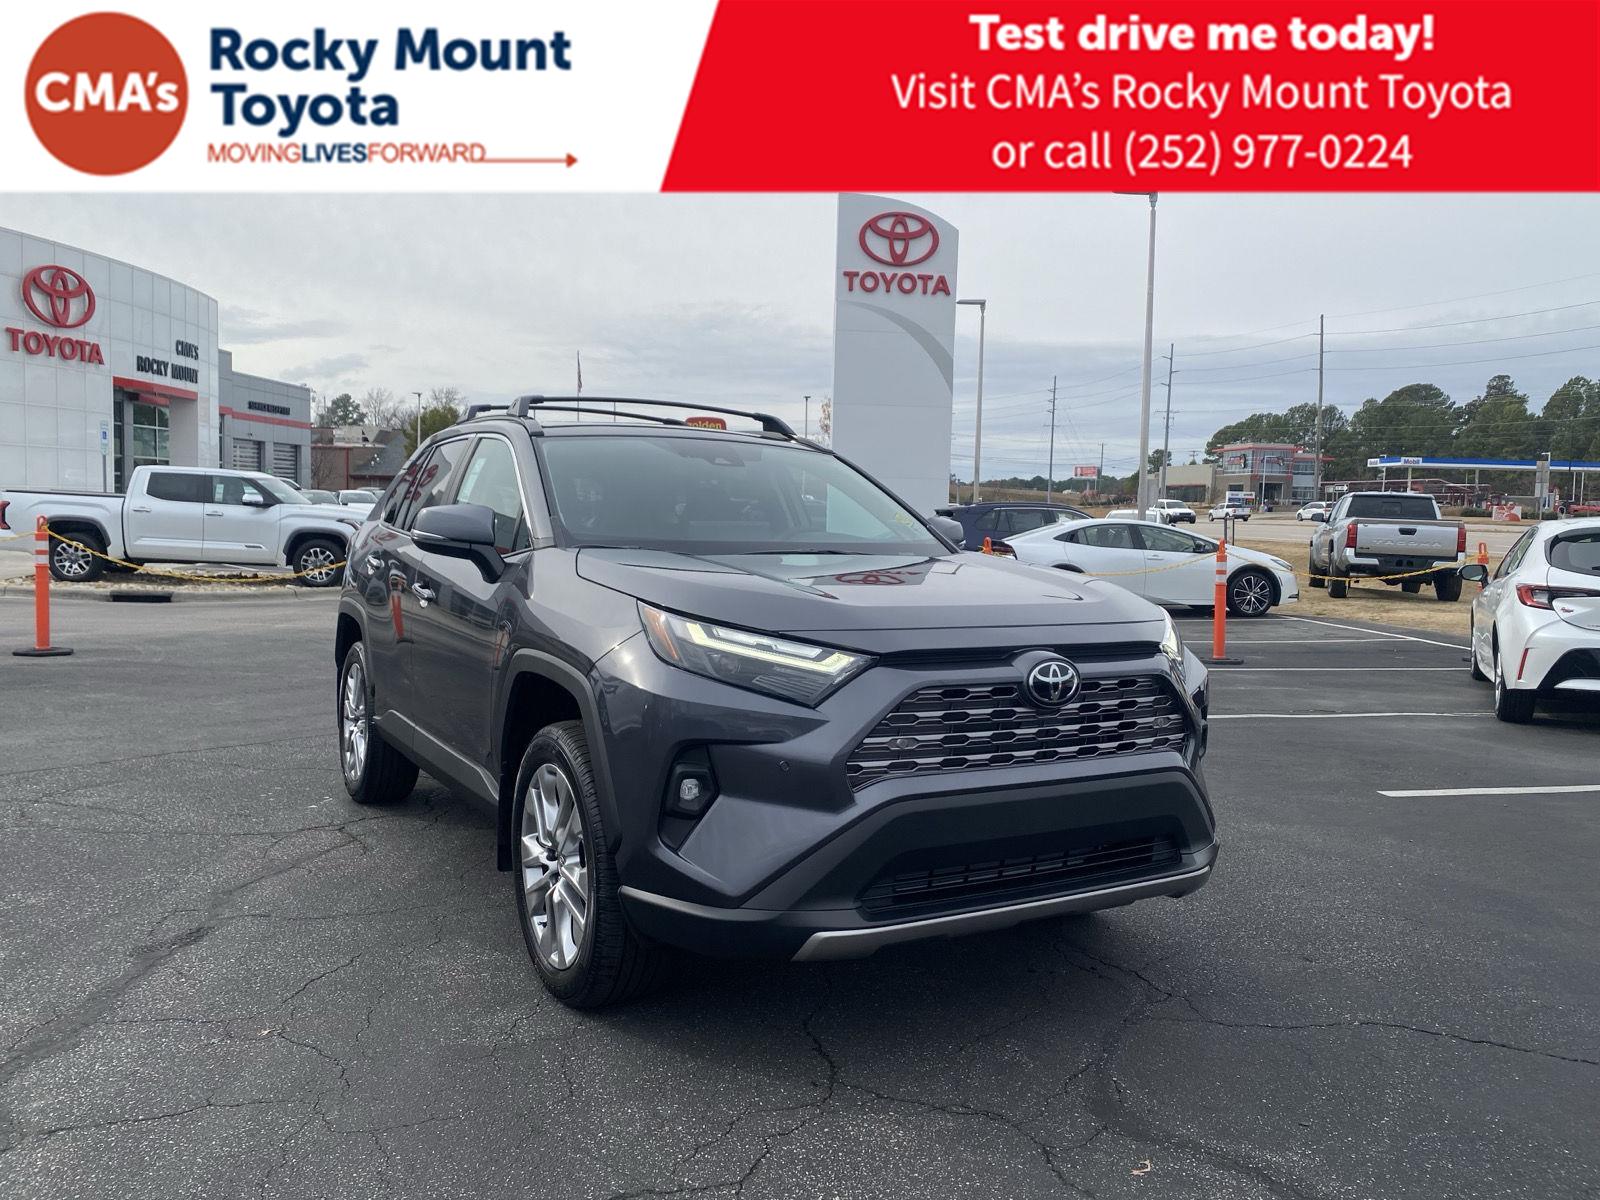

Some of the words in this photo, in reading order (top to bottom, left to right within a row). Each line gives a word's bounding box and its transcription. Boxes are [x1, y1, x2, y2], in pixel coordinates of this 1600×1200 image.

[843, 271, 951, 297] TOYOTA
[5, 326, 105, 365] TOYOTA
[136, 355, 169, 377] ROCKY
[171, 363, 199, 384] MOUNT
